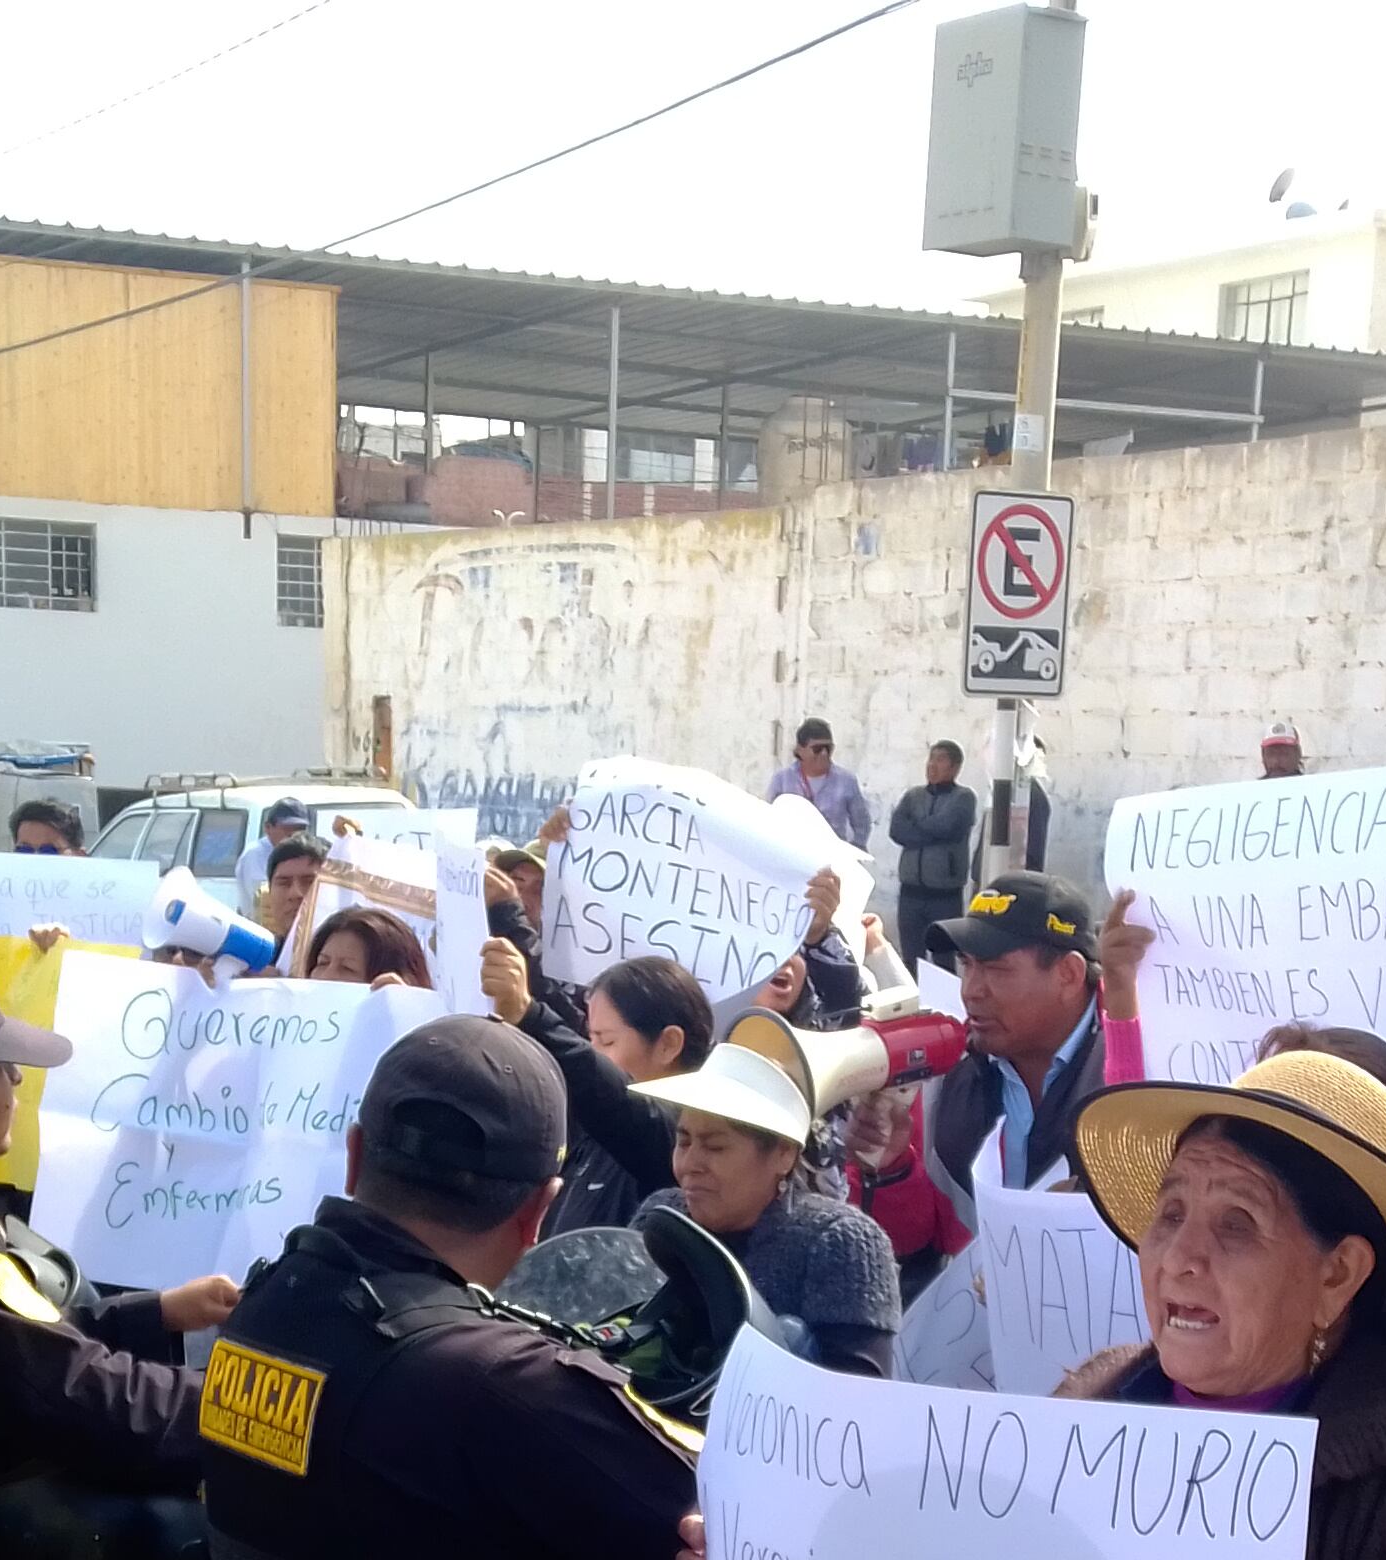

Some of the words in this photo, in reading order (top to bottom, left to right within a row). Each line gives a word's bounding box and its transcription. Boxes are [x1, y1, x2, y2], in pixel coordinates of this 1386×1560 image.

[85, 877, 118, 900] se
[1149, 895, 1180, 945] A
[1192, 892, 1269, 950] UNA
[1154, 963, 1278, 1019] TAMBIEN
[1285, 967, 1330, 1020] ES
[121, 987, 341, 1060] Queremos
[1168, 1039, 1261, 1085] CONT
[90, 1073, 250, 1134] Cambio
[285, 1081, 361, 1134] Medi
[204, 1349, 310, 1437] POLICIA
[723, 1356, 872, 1498] Veronica
[918, 1404, 1030, 1519] NO
[1051, 1422, 1301, 1541] MURIO
